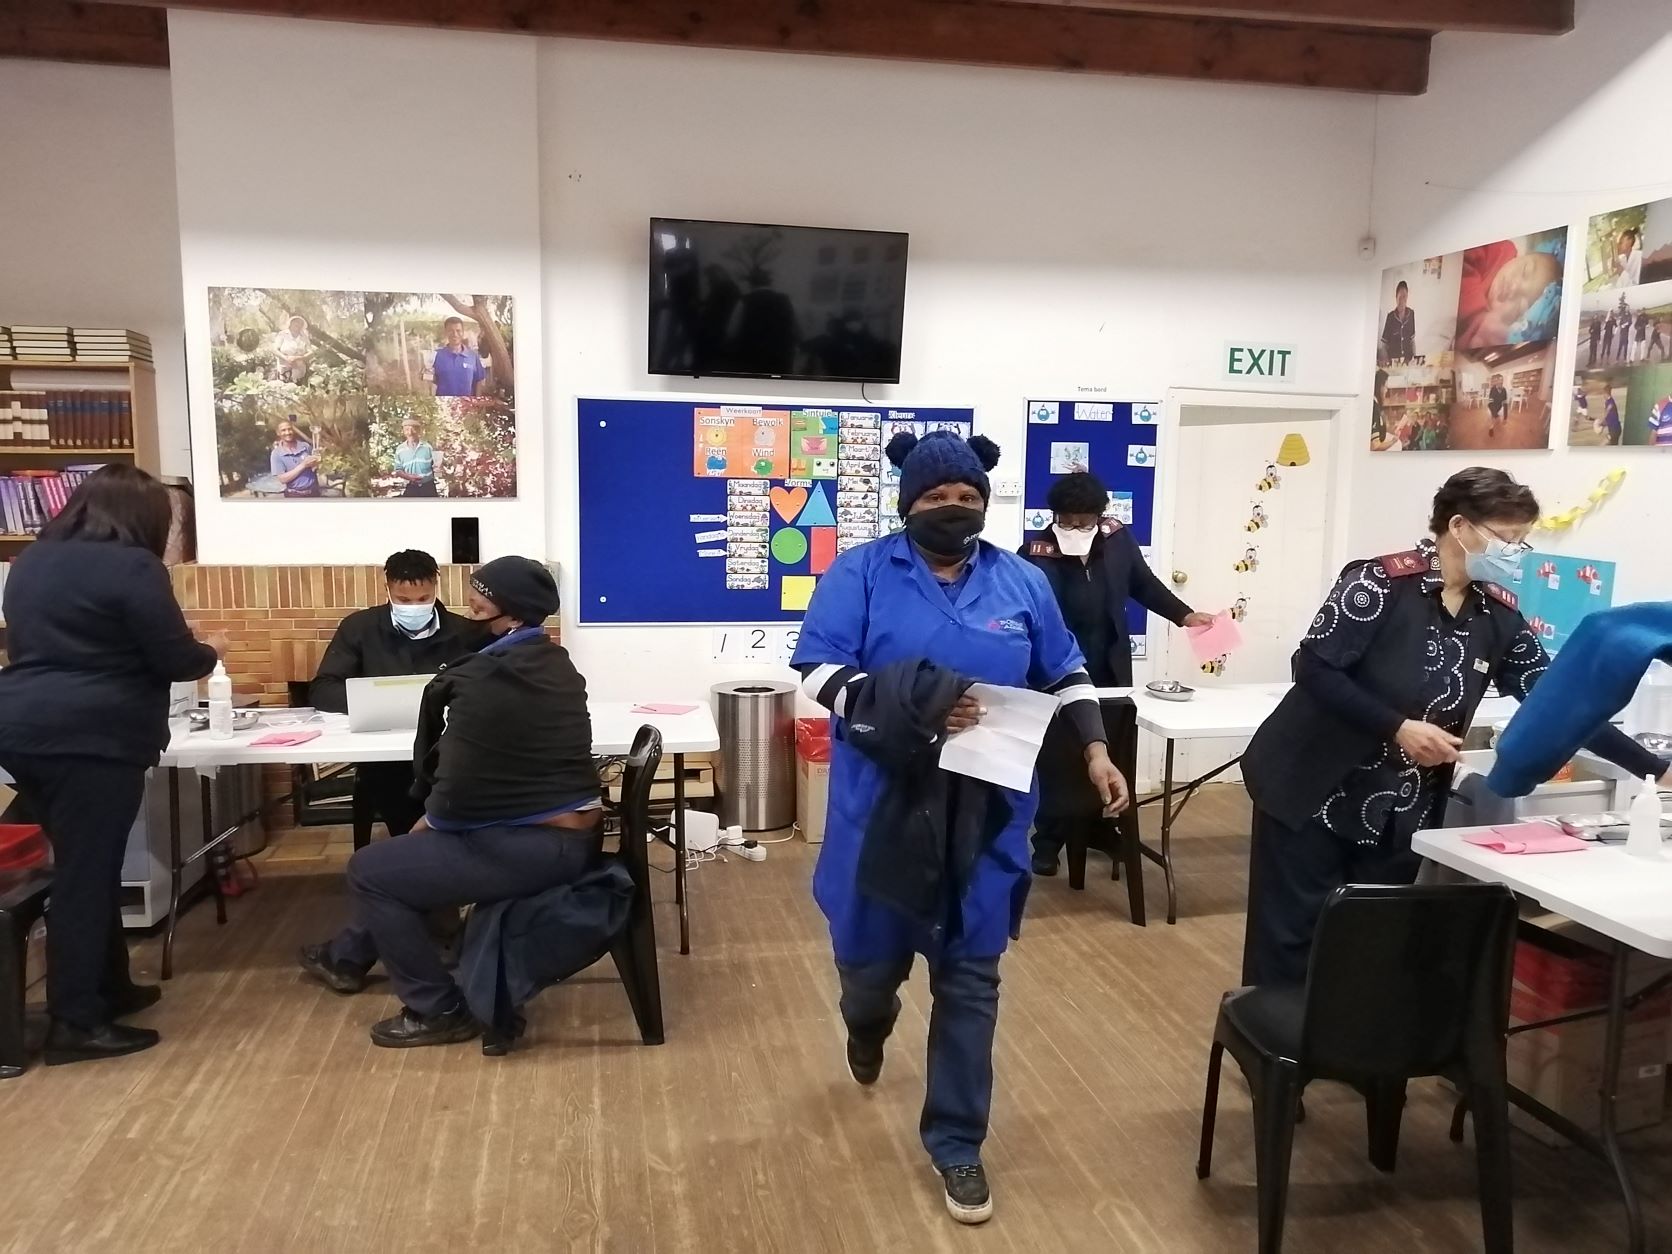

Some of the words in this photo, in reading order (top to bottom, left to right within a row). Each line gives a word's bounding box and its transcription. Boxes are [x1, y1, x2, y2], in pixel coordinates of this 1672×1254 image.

[1229, 347, 1291, 376] EXIT
[847, 412, 873, 420] Januarie
[1076, 404, 1111, 419] Water
[700, 416, 735, 427] Sonskyn
[847, 428, 878, 437] Februarie
[752, 448, 775, 457] Wind
[846, 461, 860, 471] April
[733, 481, 762, 491] Maandag
[737, 497, 763, 506] Dinsdag
[728, 513, 760, 523] Woensdag
[735, 543, 759, 554] Vrydag
[728, 558, 760, 569] Saterdag
[728, 575, 752, 585] Sondag
[751, 629, 766, 649] 2
[786, 631, 801, 650] 3
